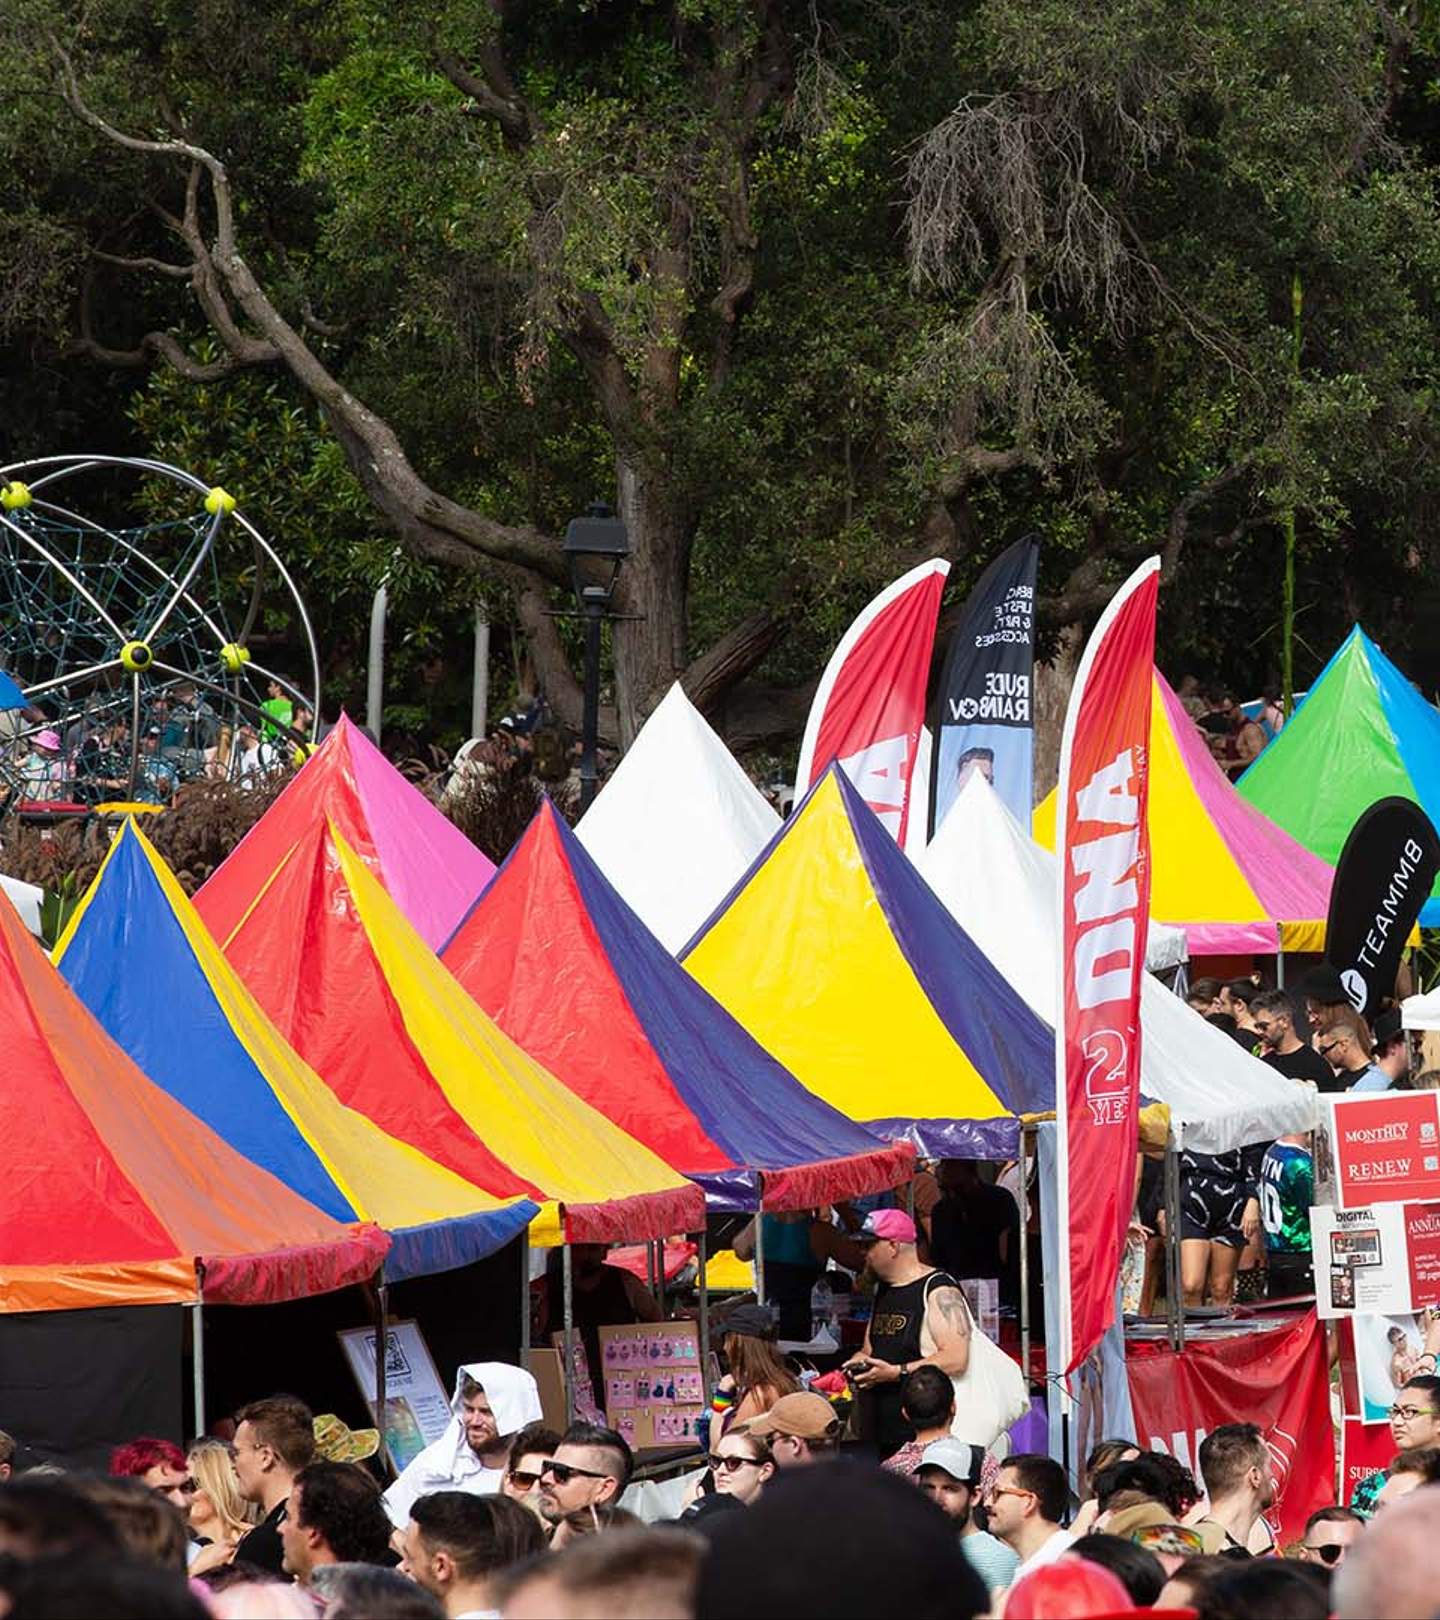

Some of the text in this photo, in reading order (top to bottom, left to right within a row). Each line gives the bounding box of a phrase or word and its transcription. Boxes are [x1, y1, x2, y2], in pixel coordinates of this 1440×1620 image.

[1345, 1124, 1408, 1143] MONTHLY
[1349, 1158, 1411, 1178] RENEW
[1335, 1211, 1376, 1222] DIGITAL
